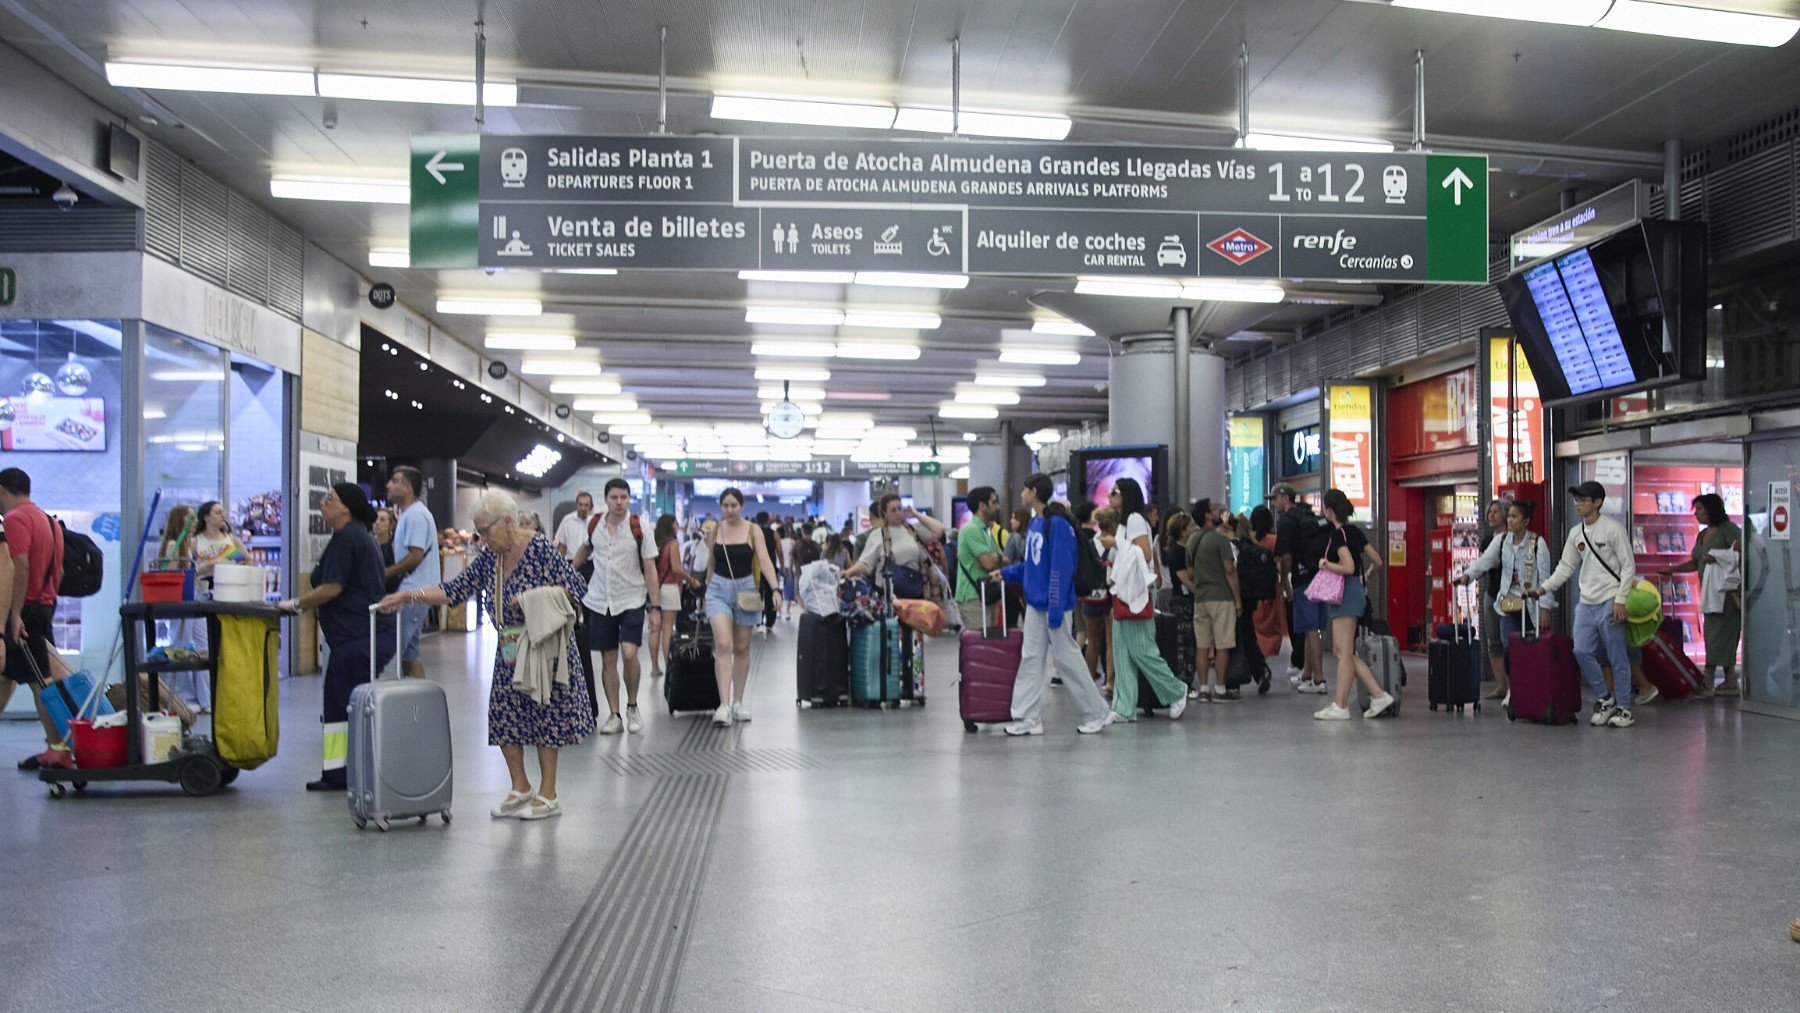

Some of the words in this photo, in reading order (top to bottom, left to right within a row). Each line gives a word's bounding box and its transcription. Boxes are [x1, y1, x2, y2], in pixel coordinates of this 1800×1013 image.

[548, 148, 621, 168] Salidas
[629, 149, 694, 169] Planta
[702, 150, 713, 168] 1
[548, 175, 634, 190] DEPARTURES
[639, 176, 681, 190] FLOOR
[685, 177, 694, 190] 1
[750, 150, 817, 171] Puerta
[824, 151, 849, 171] de
[855, 151, 924, 173] Atocha
[930, 153, 1032, 175] Almudena
[1039, 156, 1120, 177] Grandes
[1127, 158, 1212, 181] Llegadas
[1216, 159, 1256, 180] Vías
[1268, 162, 1291, 202] 1
[1300, 165, 1312, 183] a
[1317, 163, 1365, 203] 12
[750, 177, 802, 192] PUERTA
[806, 178, 824, 192] DE
[827, 178, 879, 193] ATOCHA
[882, 179, 958, 195] ALMUDENA
[961, 180, 1023, 196] GRANDES
[1027, 182, 1089, 197] ARRIVALS
[1093, 183, 1168, 199] PLATFORMS
[1296, 188, 1312, 202] TO
[548, 216, 616, 237] Venta
[625, 217, 653, 238] de
[662, 216, 746, 239] billetes
[1548, 224, 1560, 237] tren
[1560, 222, 1564, 232] a
[1564, 218, 1571, 231] su
[1571, 206, 1596, 227] estación
[811, 222, 864, 241] Aseos
[976, 229, 1051, 252] Alquiler
[1056, 232, 1079, 250] de
[1085, 232, 1146, 252] coches
[1225, 241, 1254, 252] Metro
[1293, 229, 1357, 255] renfe
[548, 243, 593, 258] TICKET
[596, 243, 636, 258] SALES
[811, 243, 852, 256] TOILETS
[1083, 254, 1105, 266] CAR
[1107, 255, 1146, 267] RENTAL
[1339, 254, 1398, 270] Cercanías
[373, 289, 391, 302] DOTS
[1334, 403, 1367, 412] tiendas
